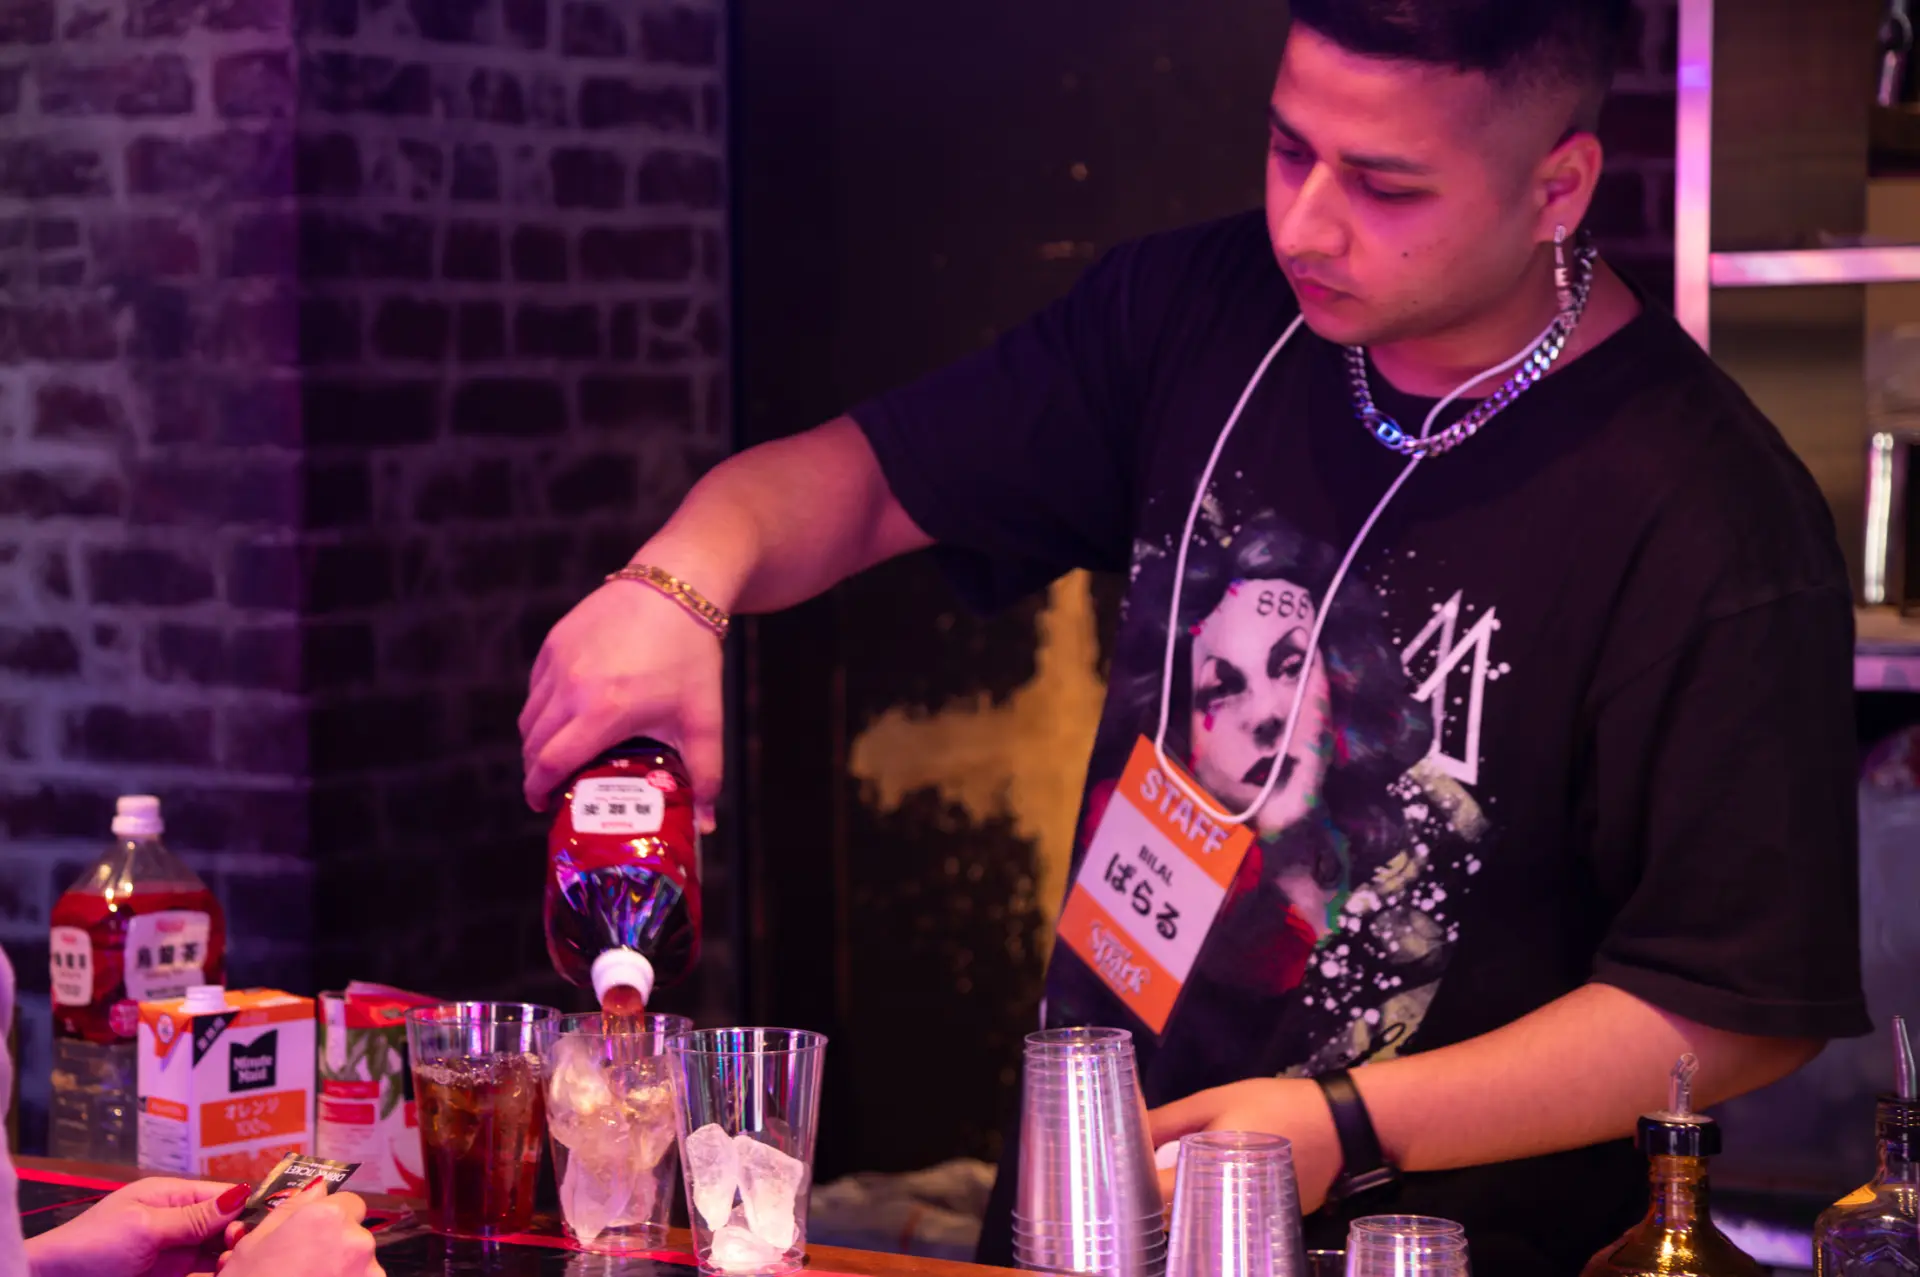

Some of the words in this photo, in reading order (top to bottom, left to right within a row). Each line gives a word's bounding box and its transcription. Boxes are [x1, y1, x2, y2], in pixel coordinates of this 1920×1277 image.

[1139, 767, 1229, 855] STAFF
[1137, 844, 1175, 887] BILAL
[1103, 852, 1181, 941] ばらる
[233, 1054, 273, 1071] Minute
[238, 1067, 268, 1084] Maid
[224, 1098, 280, 1120] オレンジ
[285, 1166, 316, 1176] TICKET
